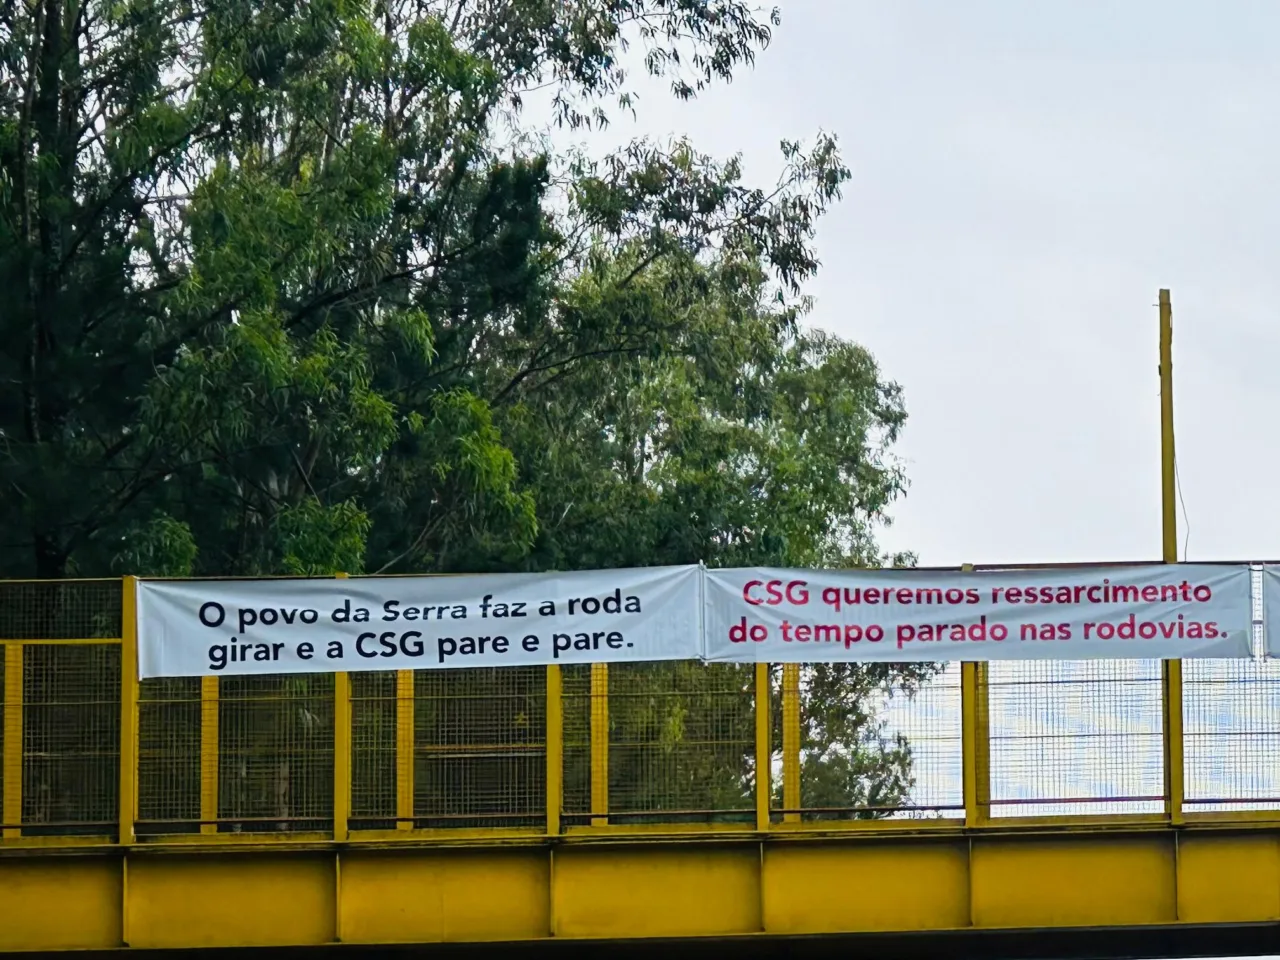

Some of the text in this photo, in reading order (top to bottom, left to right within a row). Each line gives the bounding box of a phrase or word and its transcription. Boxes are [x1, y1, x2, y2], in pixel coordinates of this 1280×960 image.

[200, 588, 642, 634] O povo da Serra faz a roda
[742, 578, 1212, 611] CSG queremos ressarcimento
[208, 630, 635, 670] girar e a CSG pare e pare.
[728, 614, 1228, 649] do tempo parado nas rodovias.
